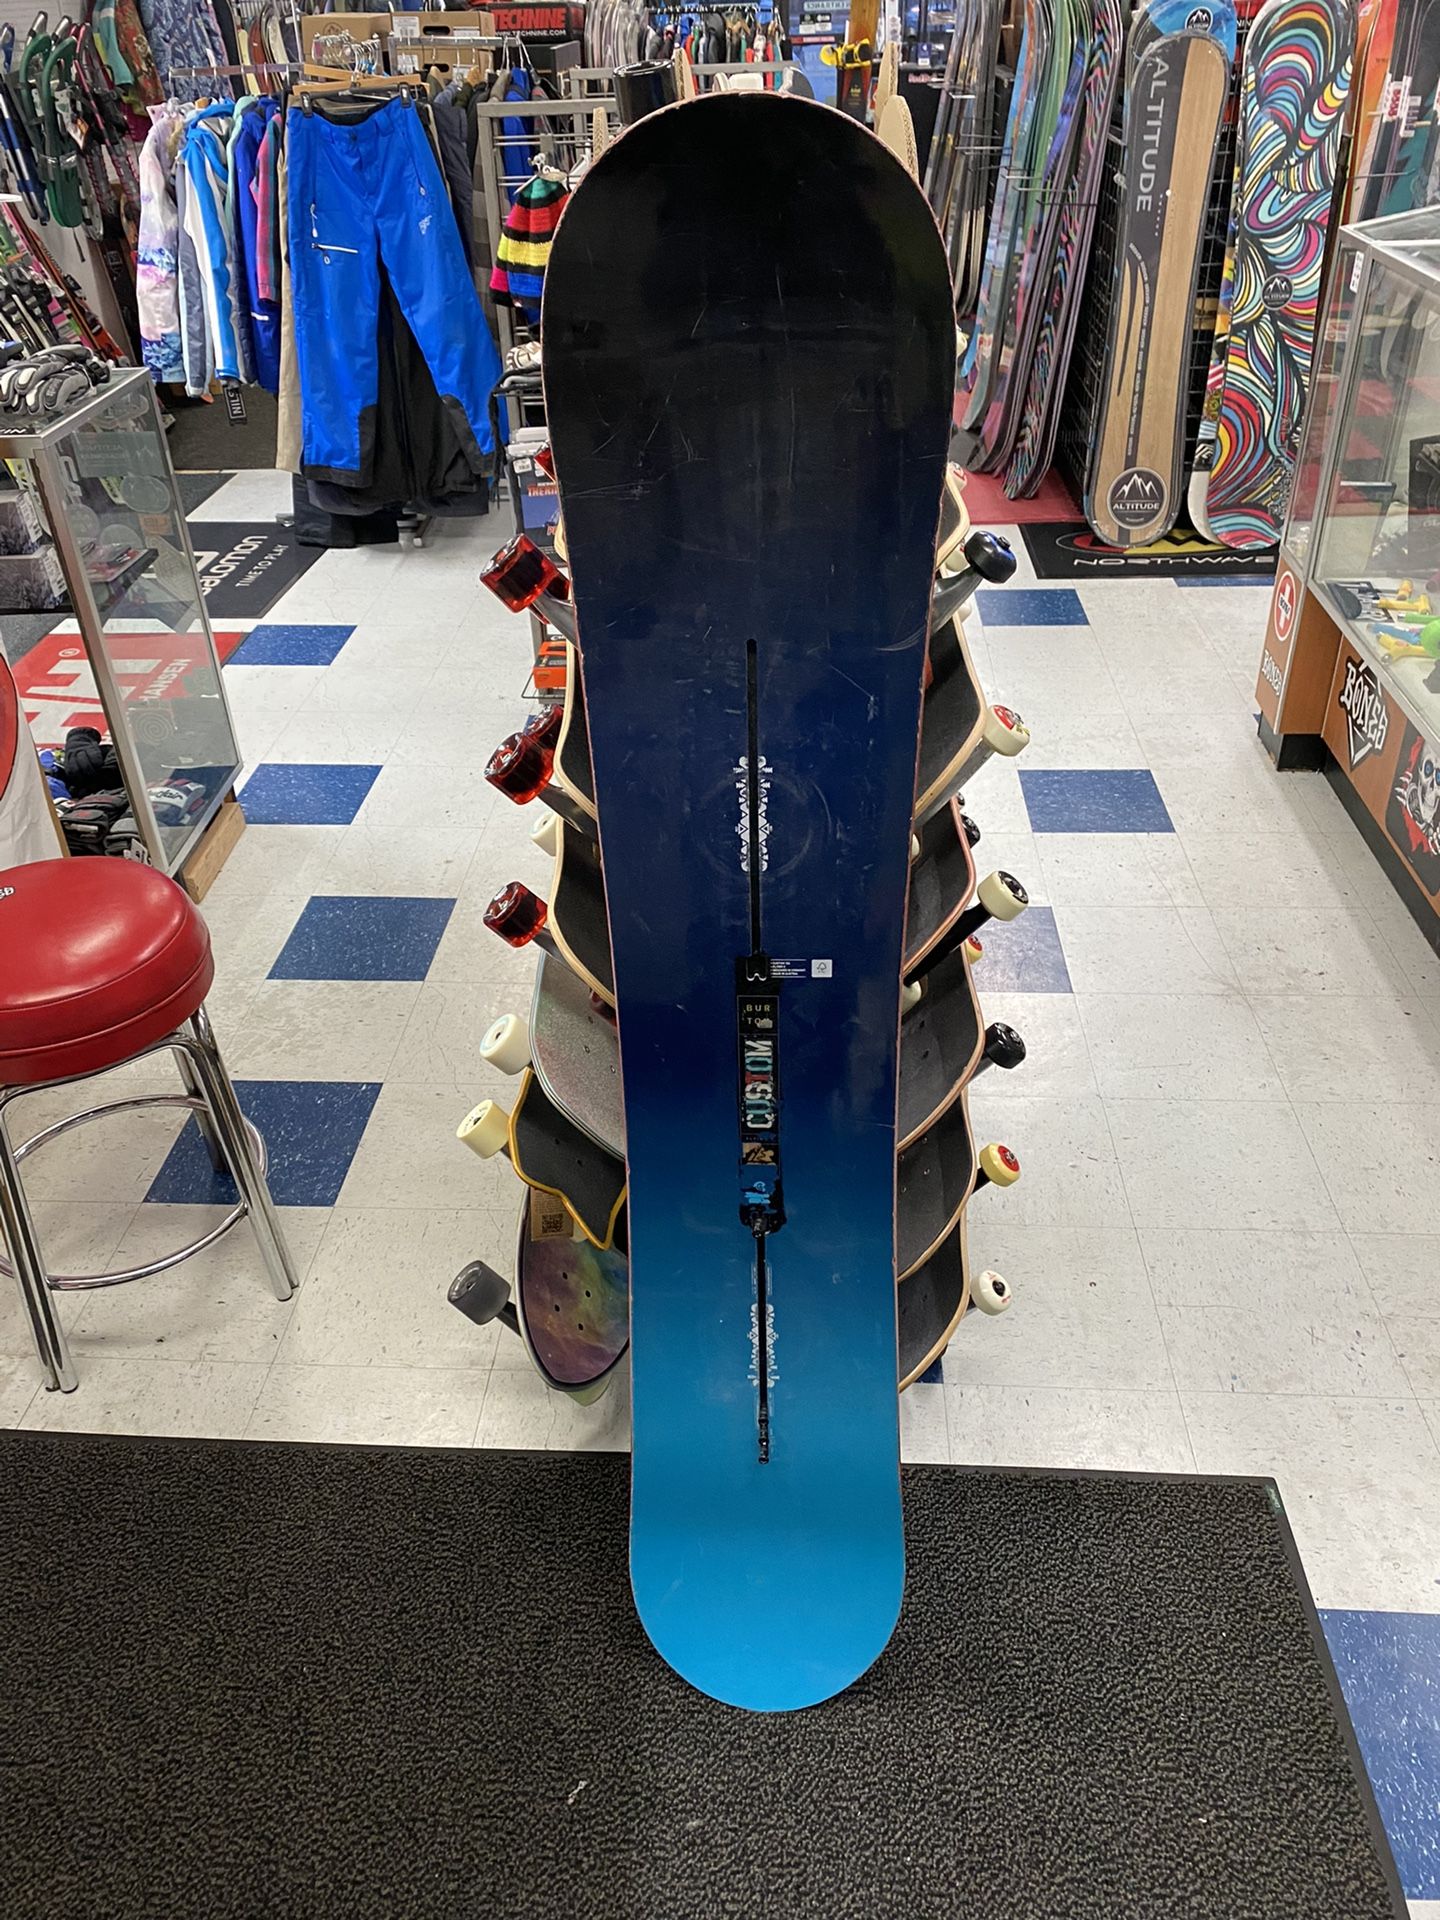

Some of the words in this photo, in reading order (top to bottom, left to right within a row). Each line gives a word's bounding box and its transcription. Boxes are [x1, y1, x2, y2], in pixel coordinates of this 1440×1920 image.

[491, 8, 566, 29] TECHNINE
[1136, 56, 1169, 212] ALTITUDE
[1112, 502, 1160, 510] ALTITUDE
[235, 571, 263, 587] TIME
[253, 560, 272, 570] TO
[264, 544, 289, 560] PLAY
[1073, 555, 1275, 566] NORTHWAVE
[1339, 661, 1388, 750] BONES
[746, 1004, 770, 1012] BUR
[744, 1040, 774, 1129] CUSTOM
